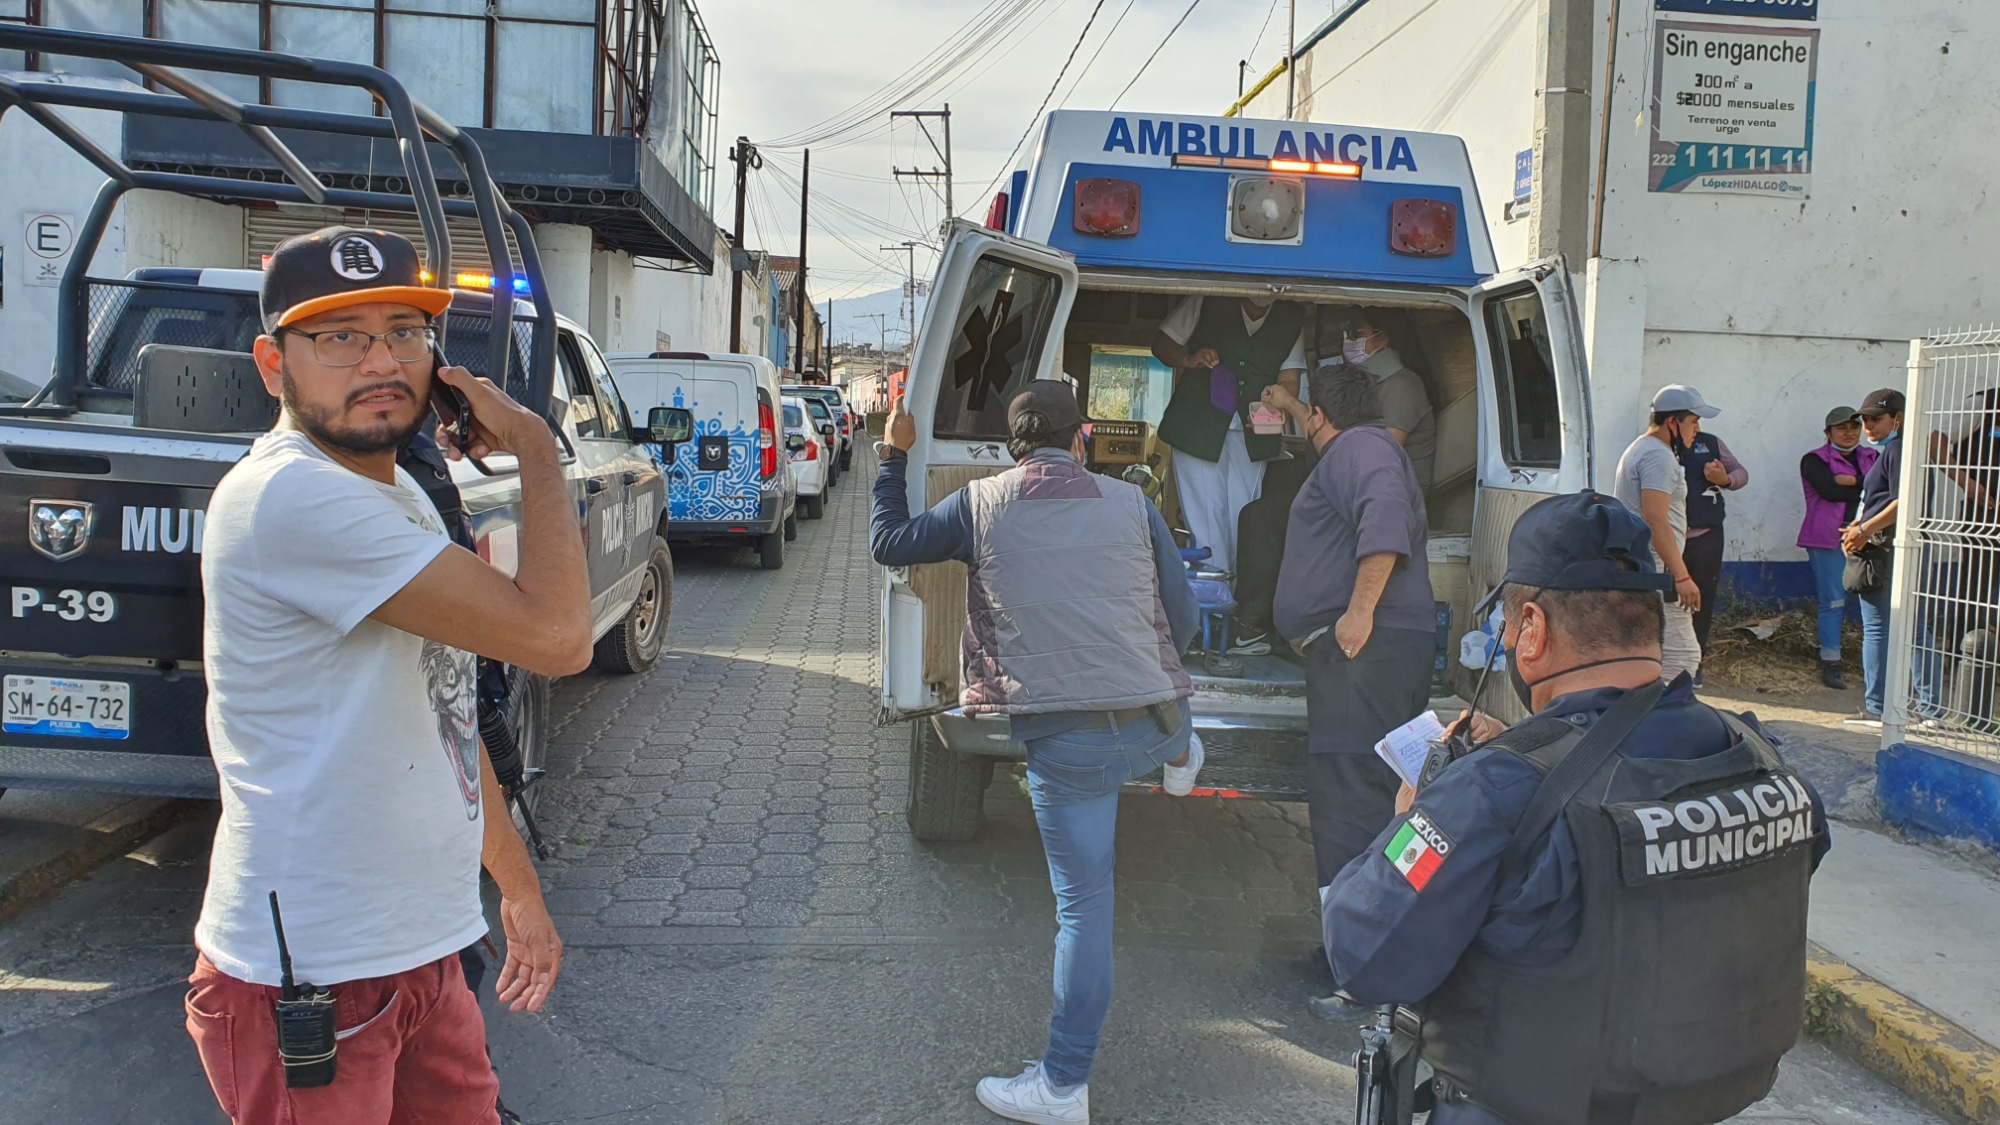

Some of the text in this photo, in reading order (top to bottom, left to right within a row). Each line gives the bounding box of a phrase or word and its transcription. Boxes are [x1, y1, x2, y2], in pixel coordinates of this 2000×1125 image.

[1666, 32, 1807, 66] Sin enganche
[1694, 72, 1722, 89] 300
[1744, 82, 1753, 90] a
[1676, 91, 1795, 111] $2000 mensuales
[1688, 114, 1777, 128] Terreno en venta
[1715, 126, 1740, 135] urge
[1102, 116, 1418, 172] AMBULANCIA
[1652, 153, 1677, 167] 222
[1685, 144, 1697, 167] 1
[1517, 156, 1532, 170] CAL
[37, 222, 61, 252] E
[11, 586, 115, 622] P-39
[7, 691, 124, 721] SM-64-732
[49, 720, 81, 729] PUEBLA
[1645, 810, 1814, 875] MUNICIPAL
